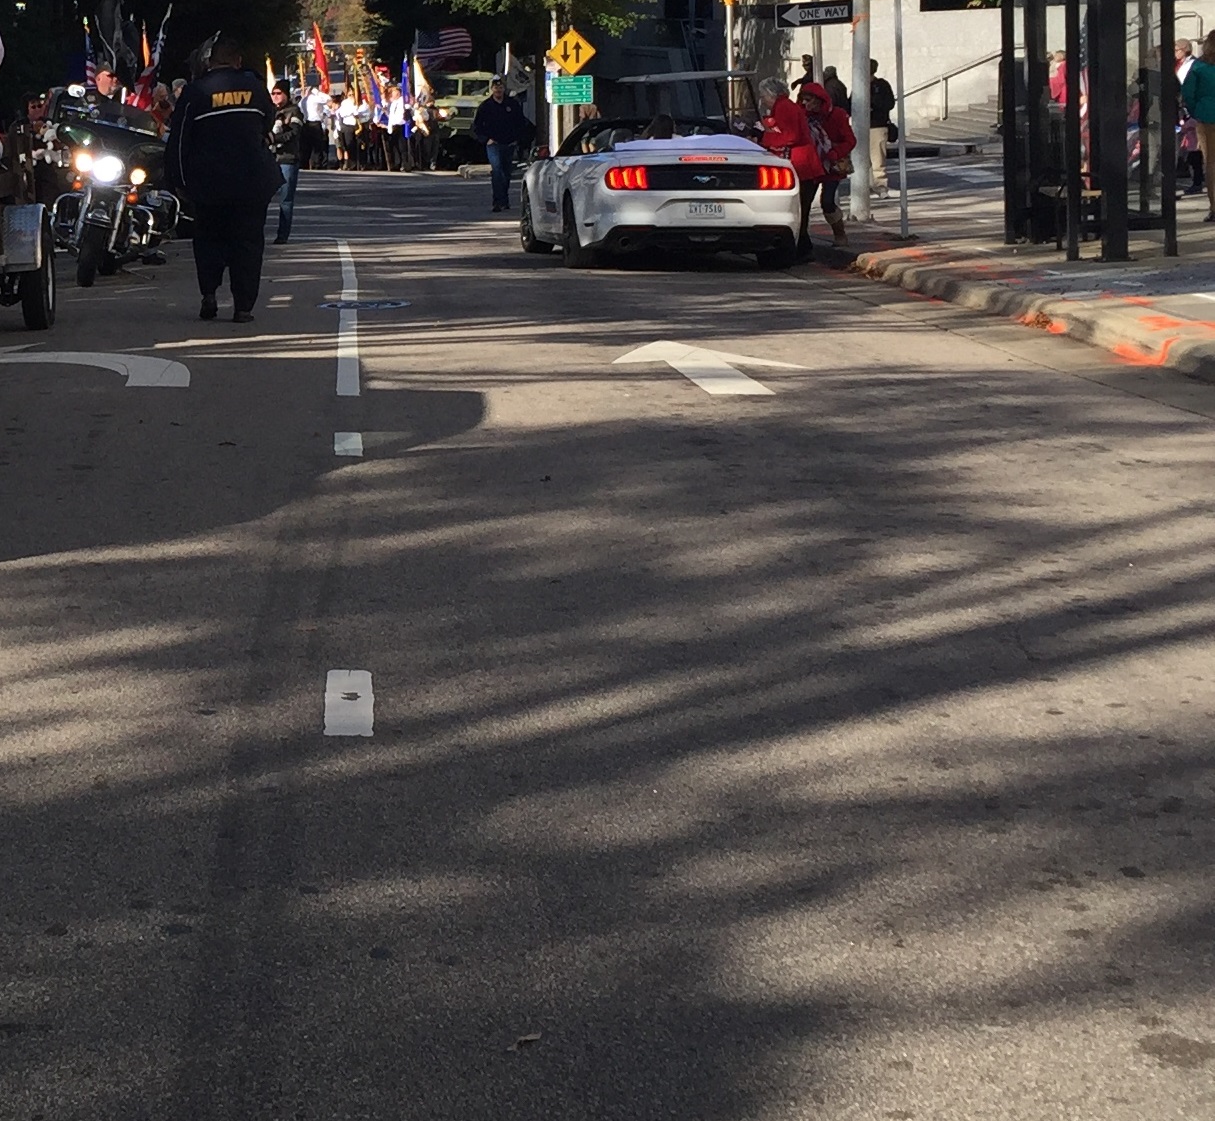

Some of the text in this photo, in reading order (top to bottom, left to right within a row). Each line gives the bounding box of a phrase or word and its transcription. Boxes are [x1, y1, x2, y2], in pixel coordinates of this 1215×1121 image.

[799, 6, 846, 19] ONE WAY
[211, 91, 252, 108] NAVY
